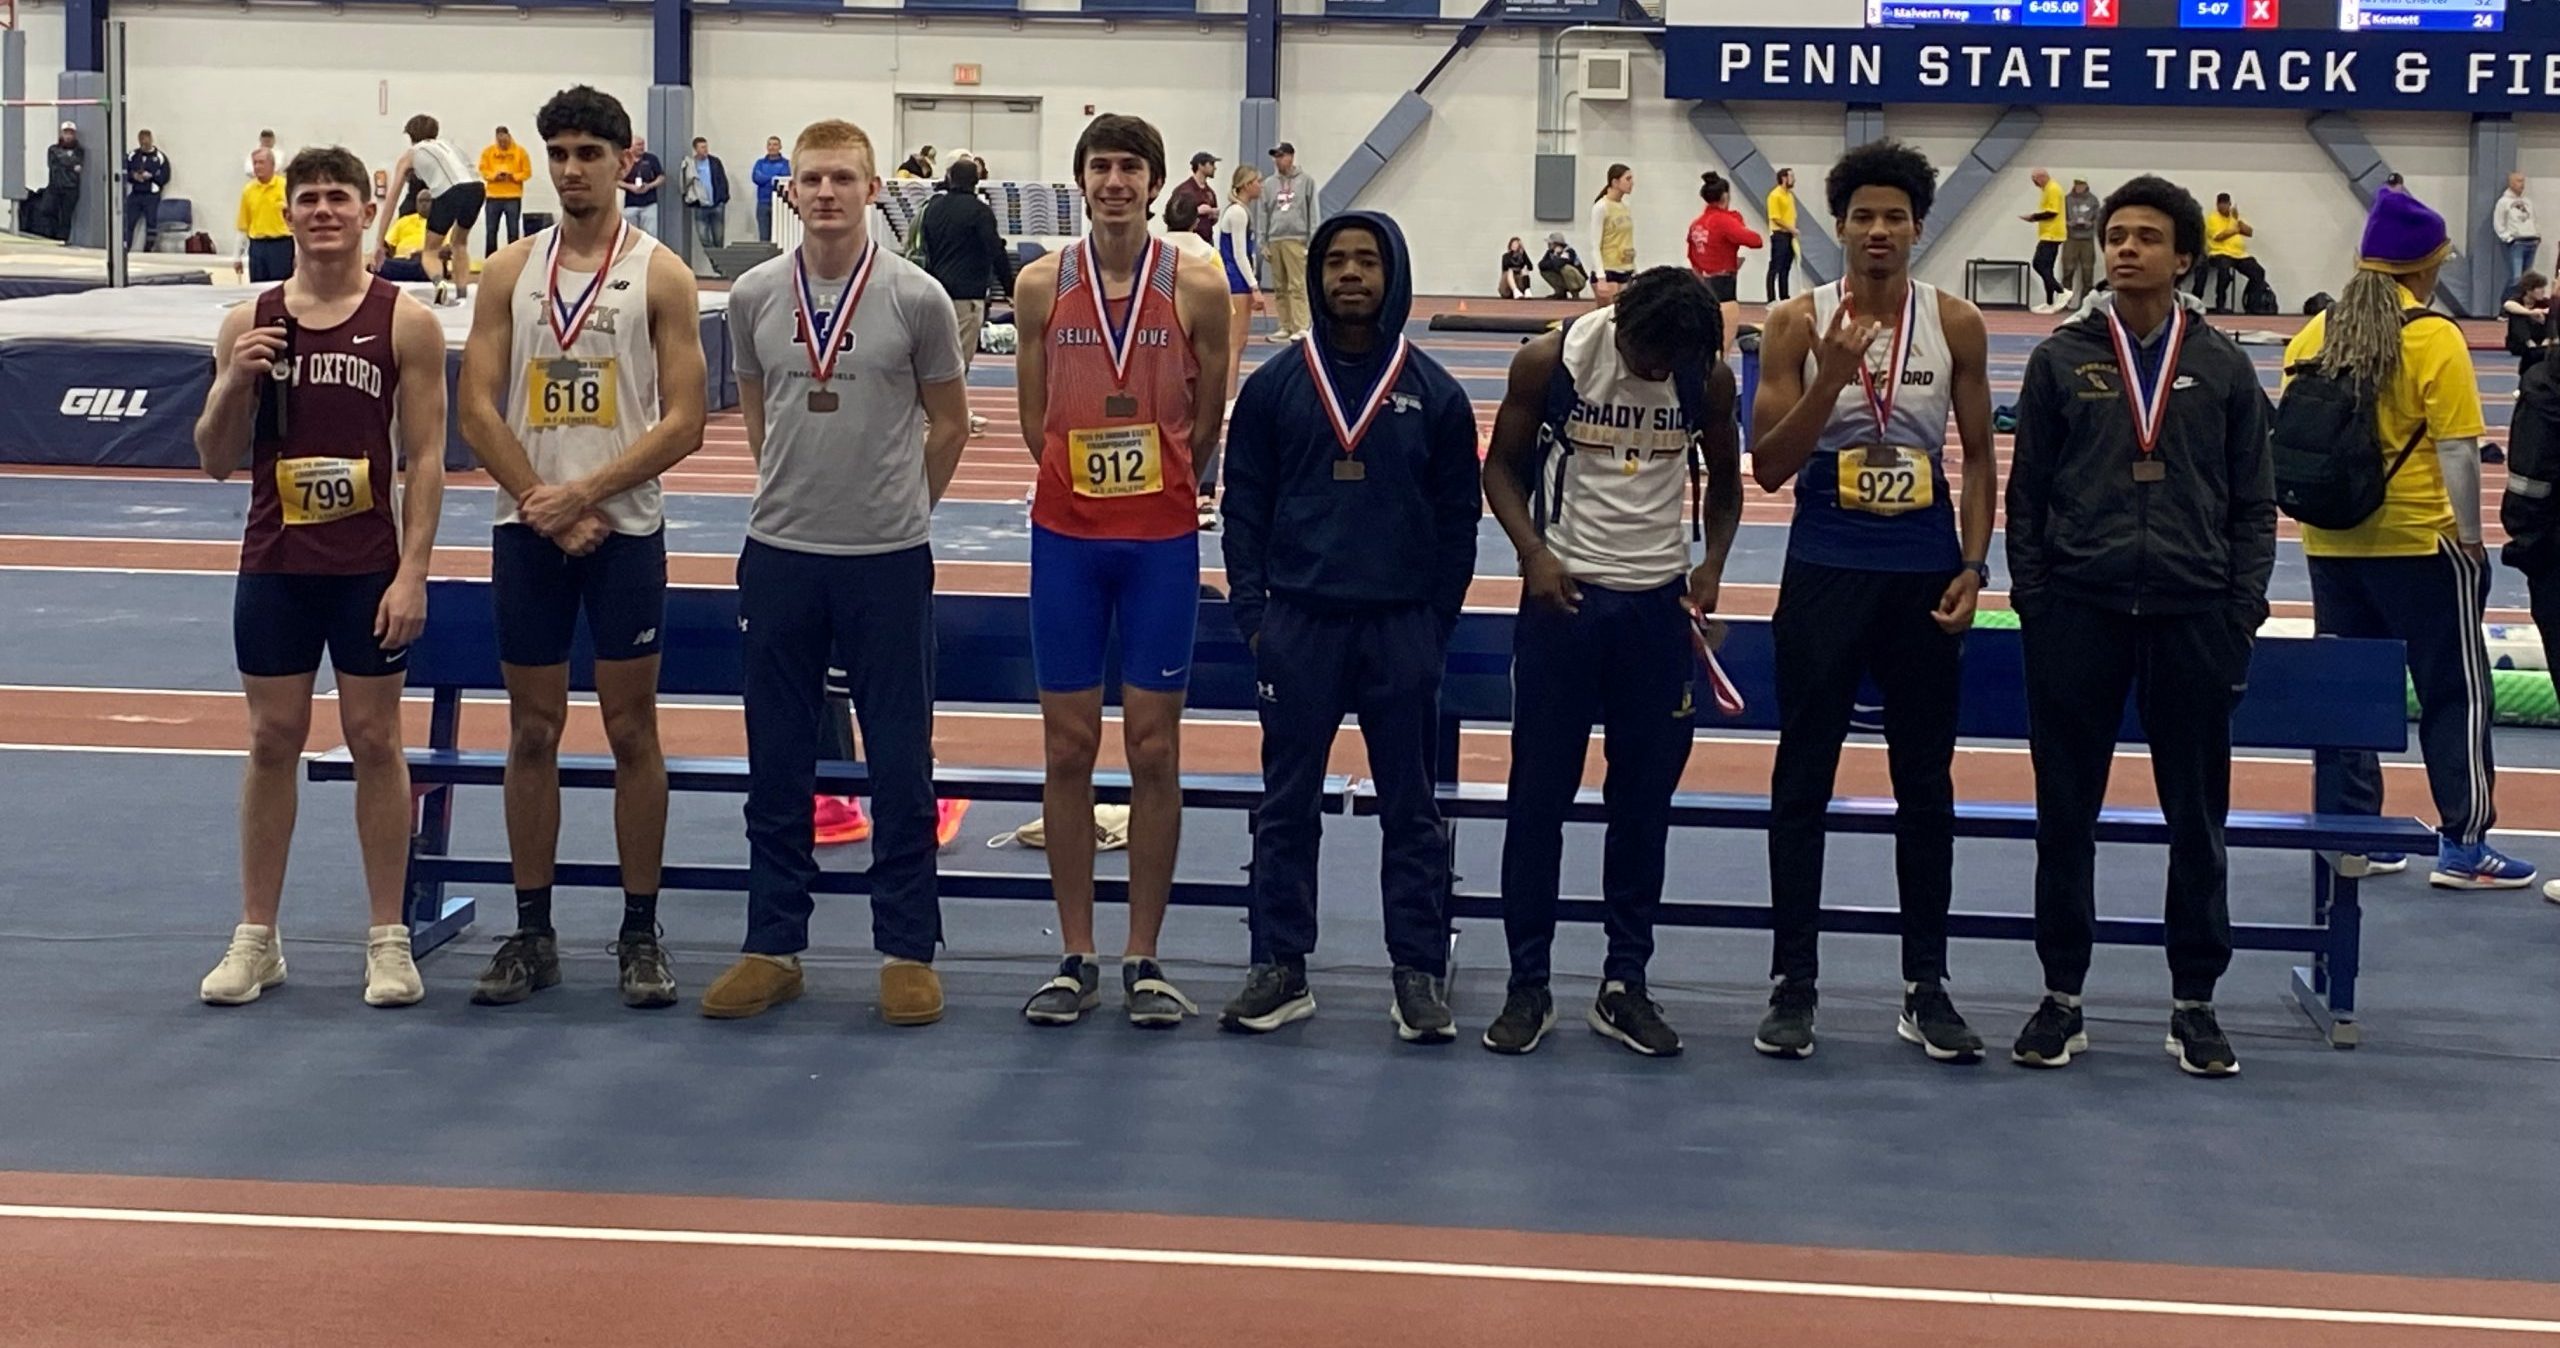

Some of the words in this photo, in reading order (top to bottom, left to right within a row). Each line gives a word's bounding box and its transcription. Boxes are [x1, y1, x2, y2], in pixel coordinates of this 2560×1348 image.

[1893, 7, 1941, 18] Malvern
[1942, 8, 1969, 22] Prep
[1992, 8, 2012, 21] 18
[2029, 1, 2079, 13] 6-05.00
[2092, 0, 2111, 17] X
[2198, 2, 2230, 15] 5-07
[2252, 0, 2270, 19] X
[2372, 14, 2420, 26] Kennett
[2472, 13, 2494, 27] 24
[1720, 42, 1882, 85] PENN
[1918, 44, 2111, 88] STATE
[2146, 48, 2359, 92] TRACK
[2395, 52, 2431, 94] &
[1056, 328, 1169, 347] SELINOVE
[309, 353, 382, 398] OXFORD
[60, 387, 149, 417] GILL
[544, 381, 600, 413] 618
[1571, 400, 1646, 429] SHADY
[1087, 449, 1146, 485] 912
[294, 478, 354, 511] 799
[1857, 470, 1916, 504] 922
